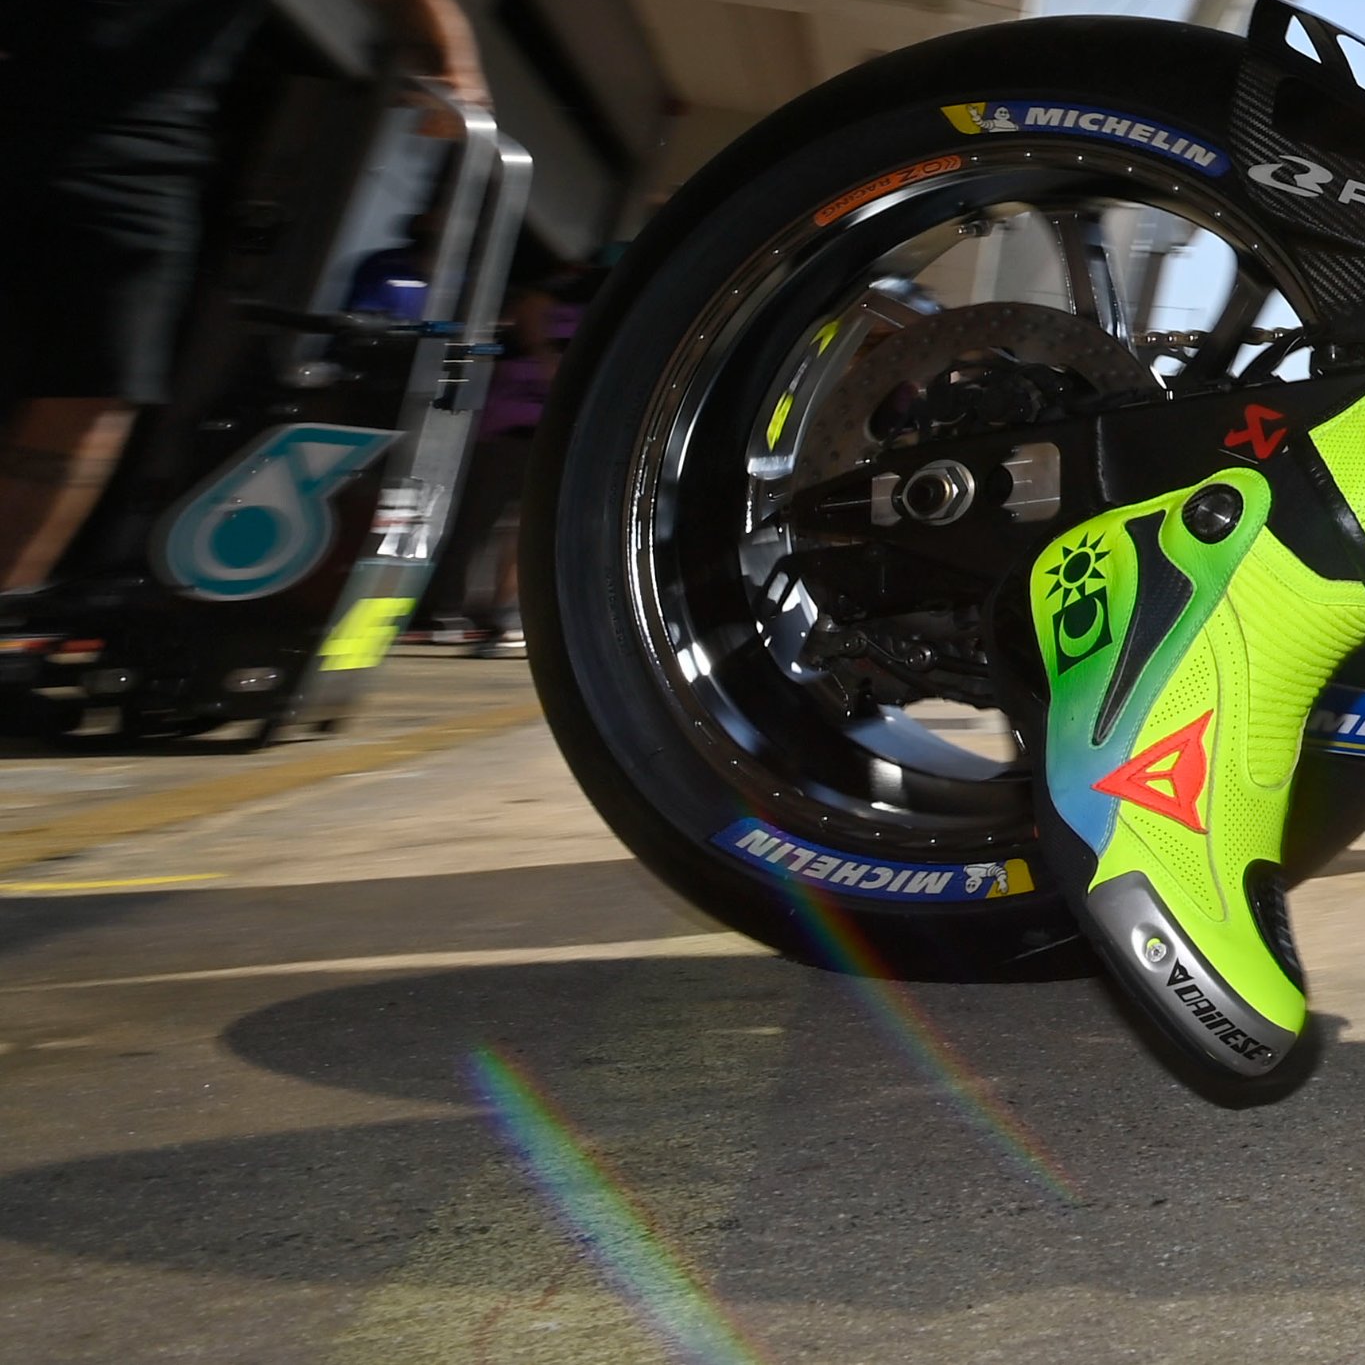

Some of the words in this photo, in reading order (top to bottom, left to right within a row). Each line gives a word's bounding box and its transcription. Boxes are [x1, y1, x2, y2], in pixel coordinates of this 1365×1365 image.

[1024, 105, 1217, 167] MICHELIN
[736, 828, 954, 895] MICHELIN
[1174, 984, 1273, 1061] DAINESE
